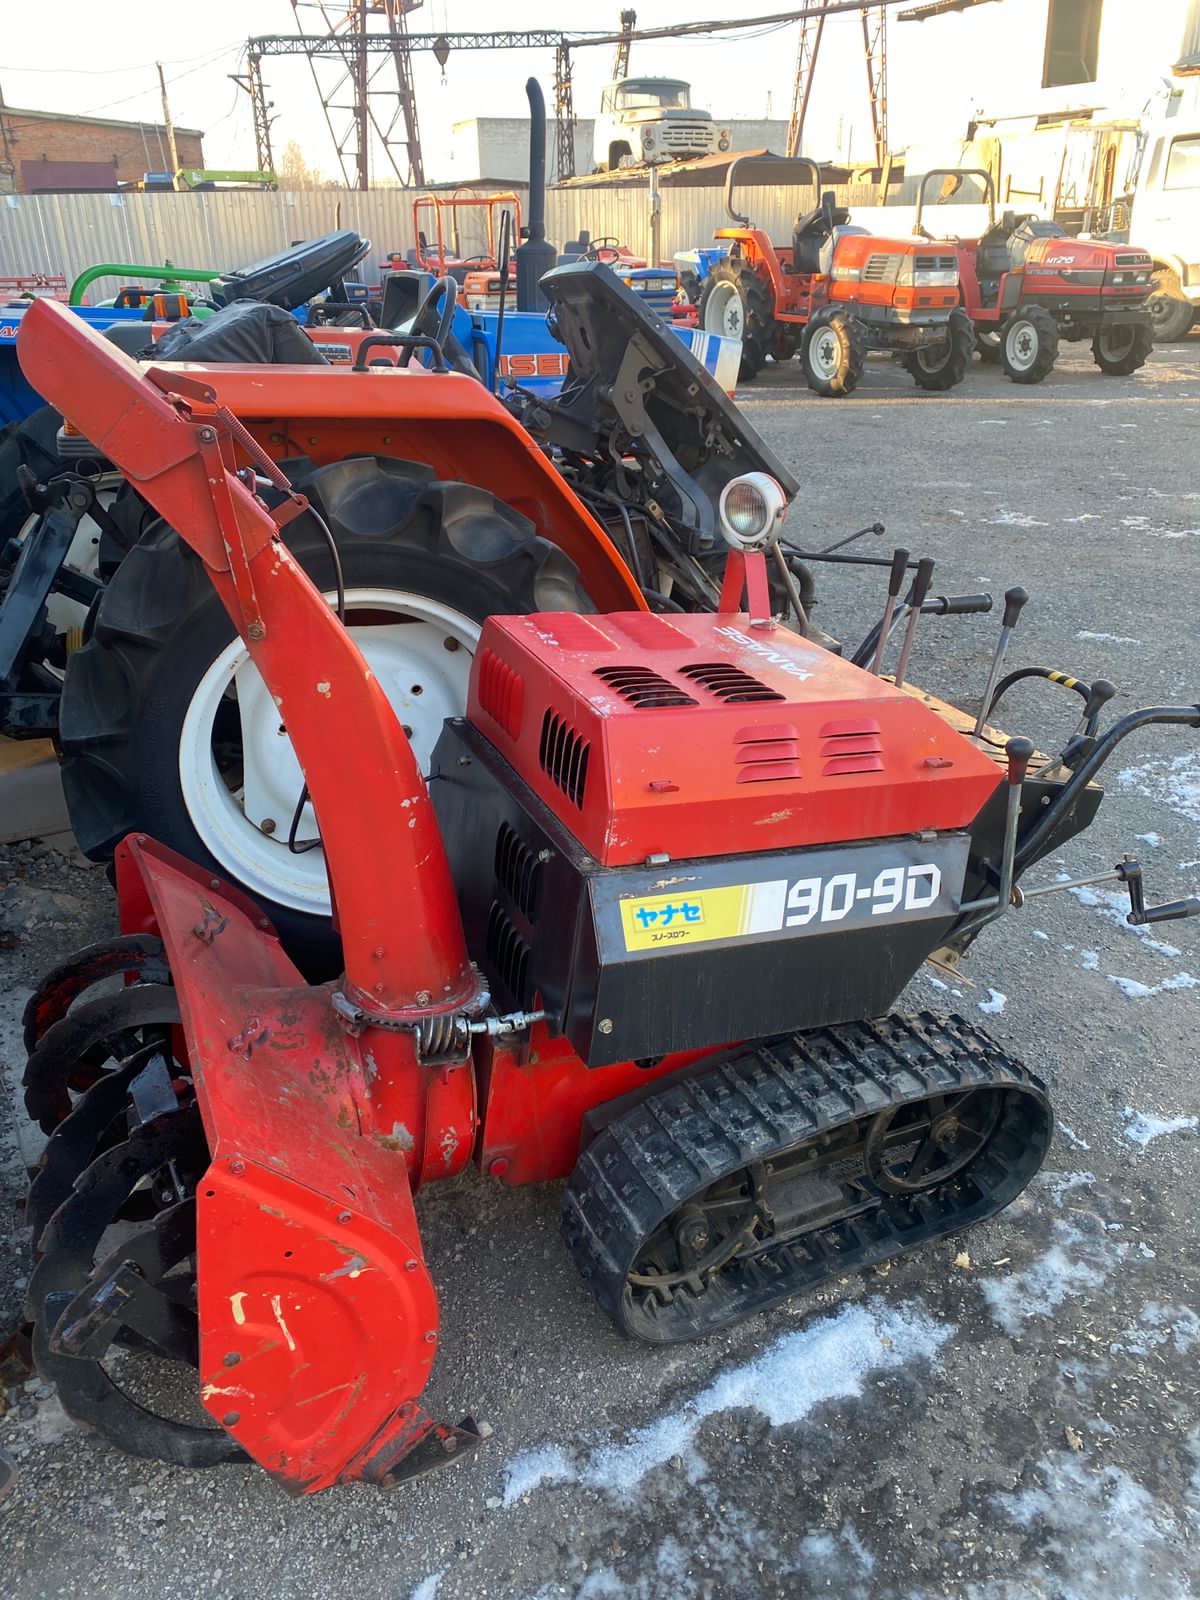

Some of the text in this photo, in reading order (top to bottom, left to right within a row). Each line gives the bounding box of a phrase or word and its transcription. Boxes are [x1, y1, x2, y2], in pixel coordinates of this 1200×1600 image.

[712, 625, 815, 682] YANASE
[635, 902, 701, 928] ヤナセ
[785, 863, 942, 927] 90-9D
